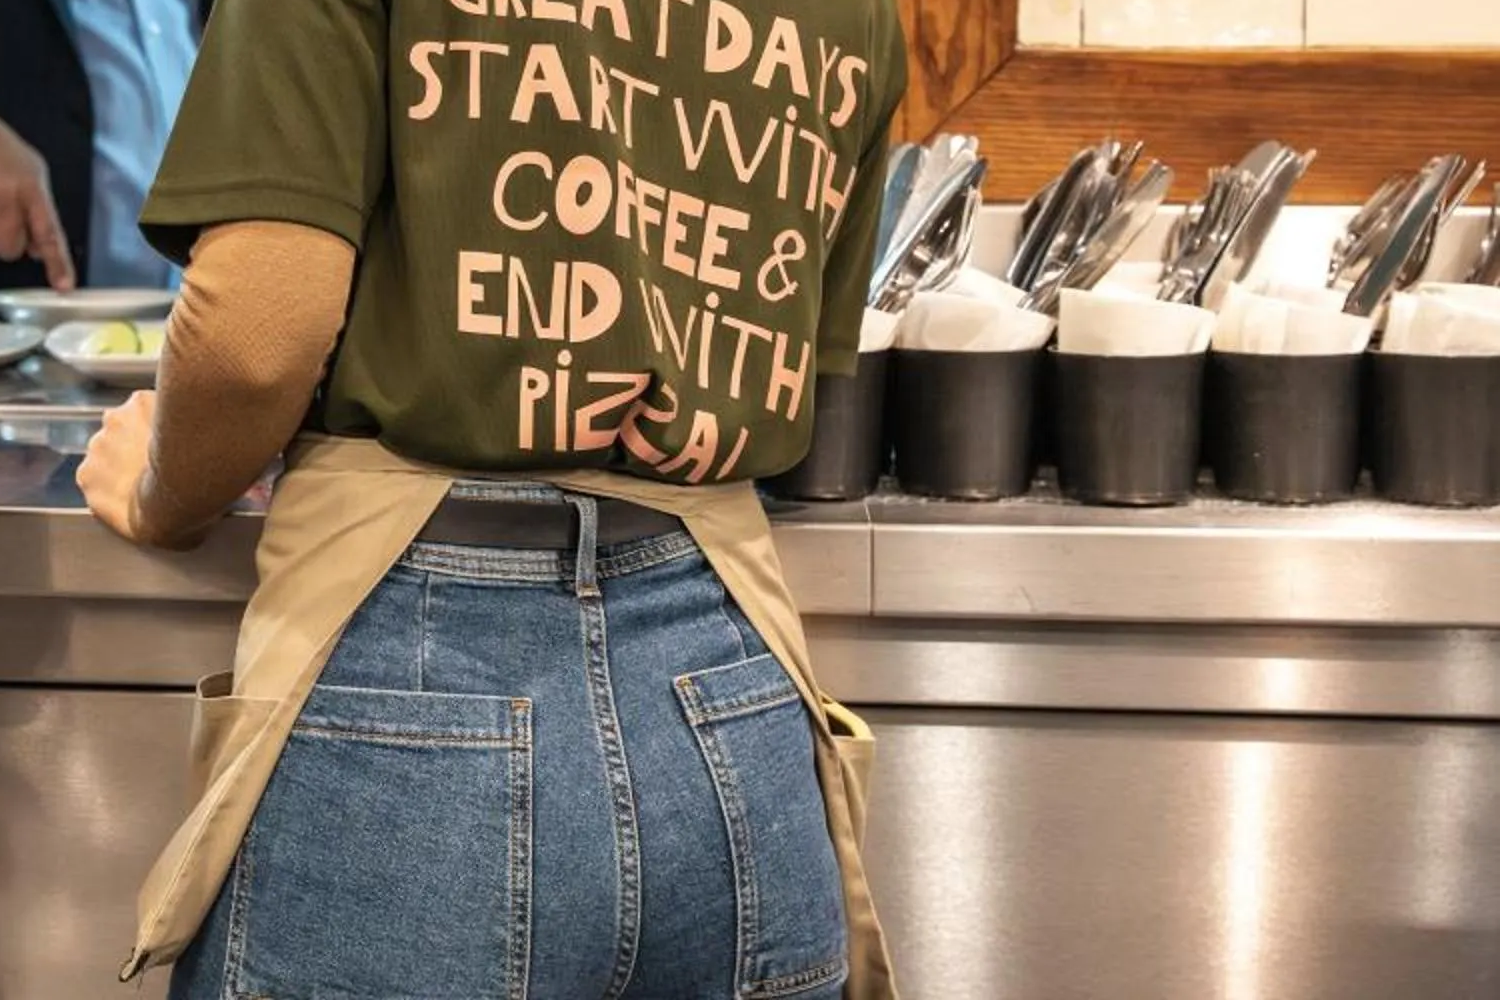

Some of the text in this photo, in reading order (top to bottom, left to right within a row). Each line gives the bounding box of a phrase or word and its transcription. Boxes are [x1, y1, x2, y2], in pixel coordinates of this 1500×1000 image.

[407, 41, 660, 148] START
[703, 0, 868, 129] DAYS
[493, 150, 806, 302] COFFEE &
[457, 249, 623, 343] END
